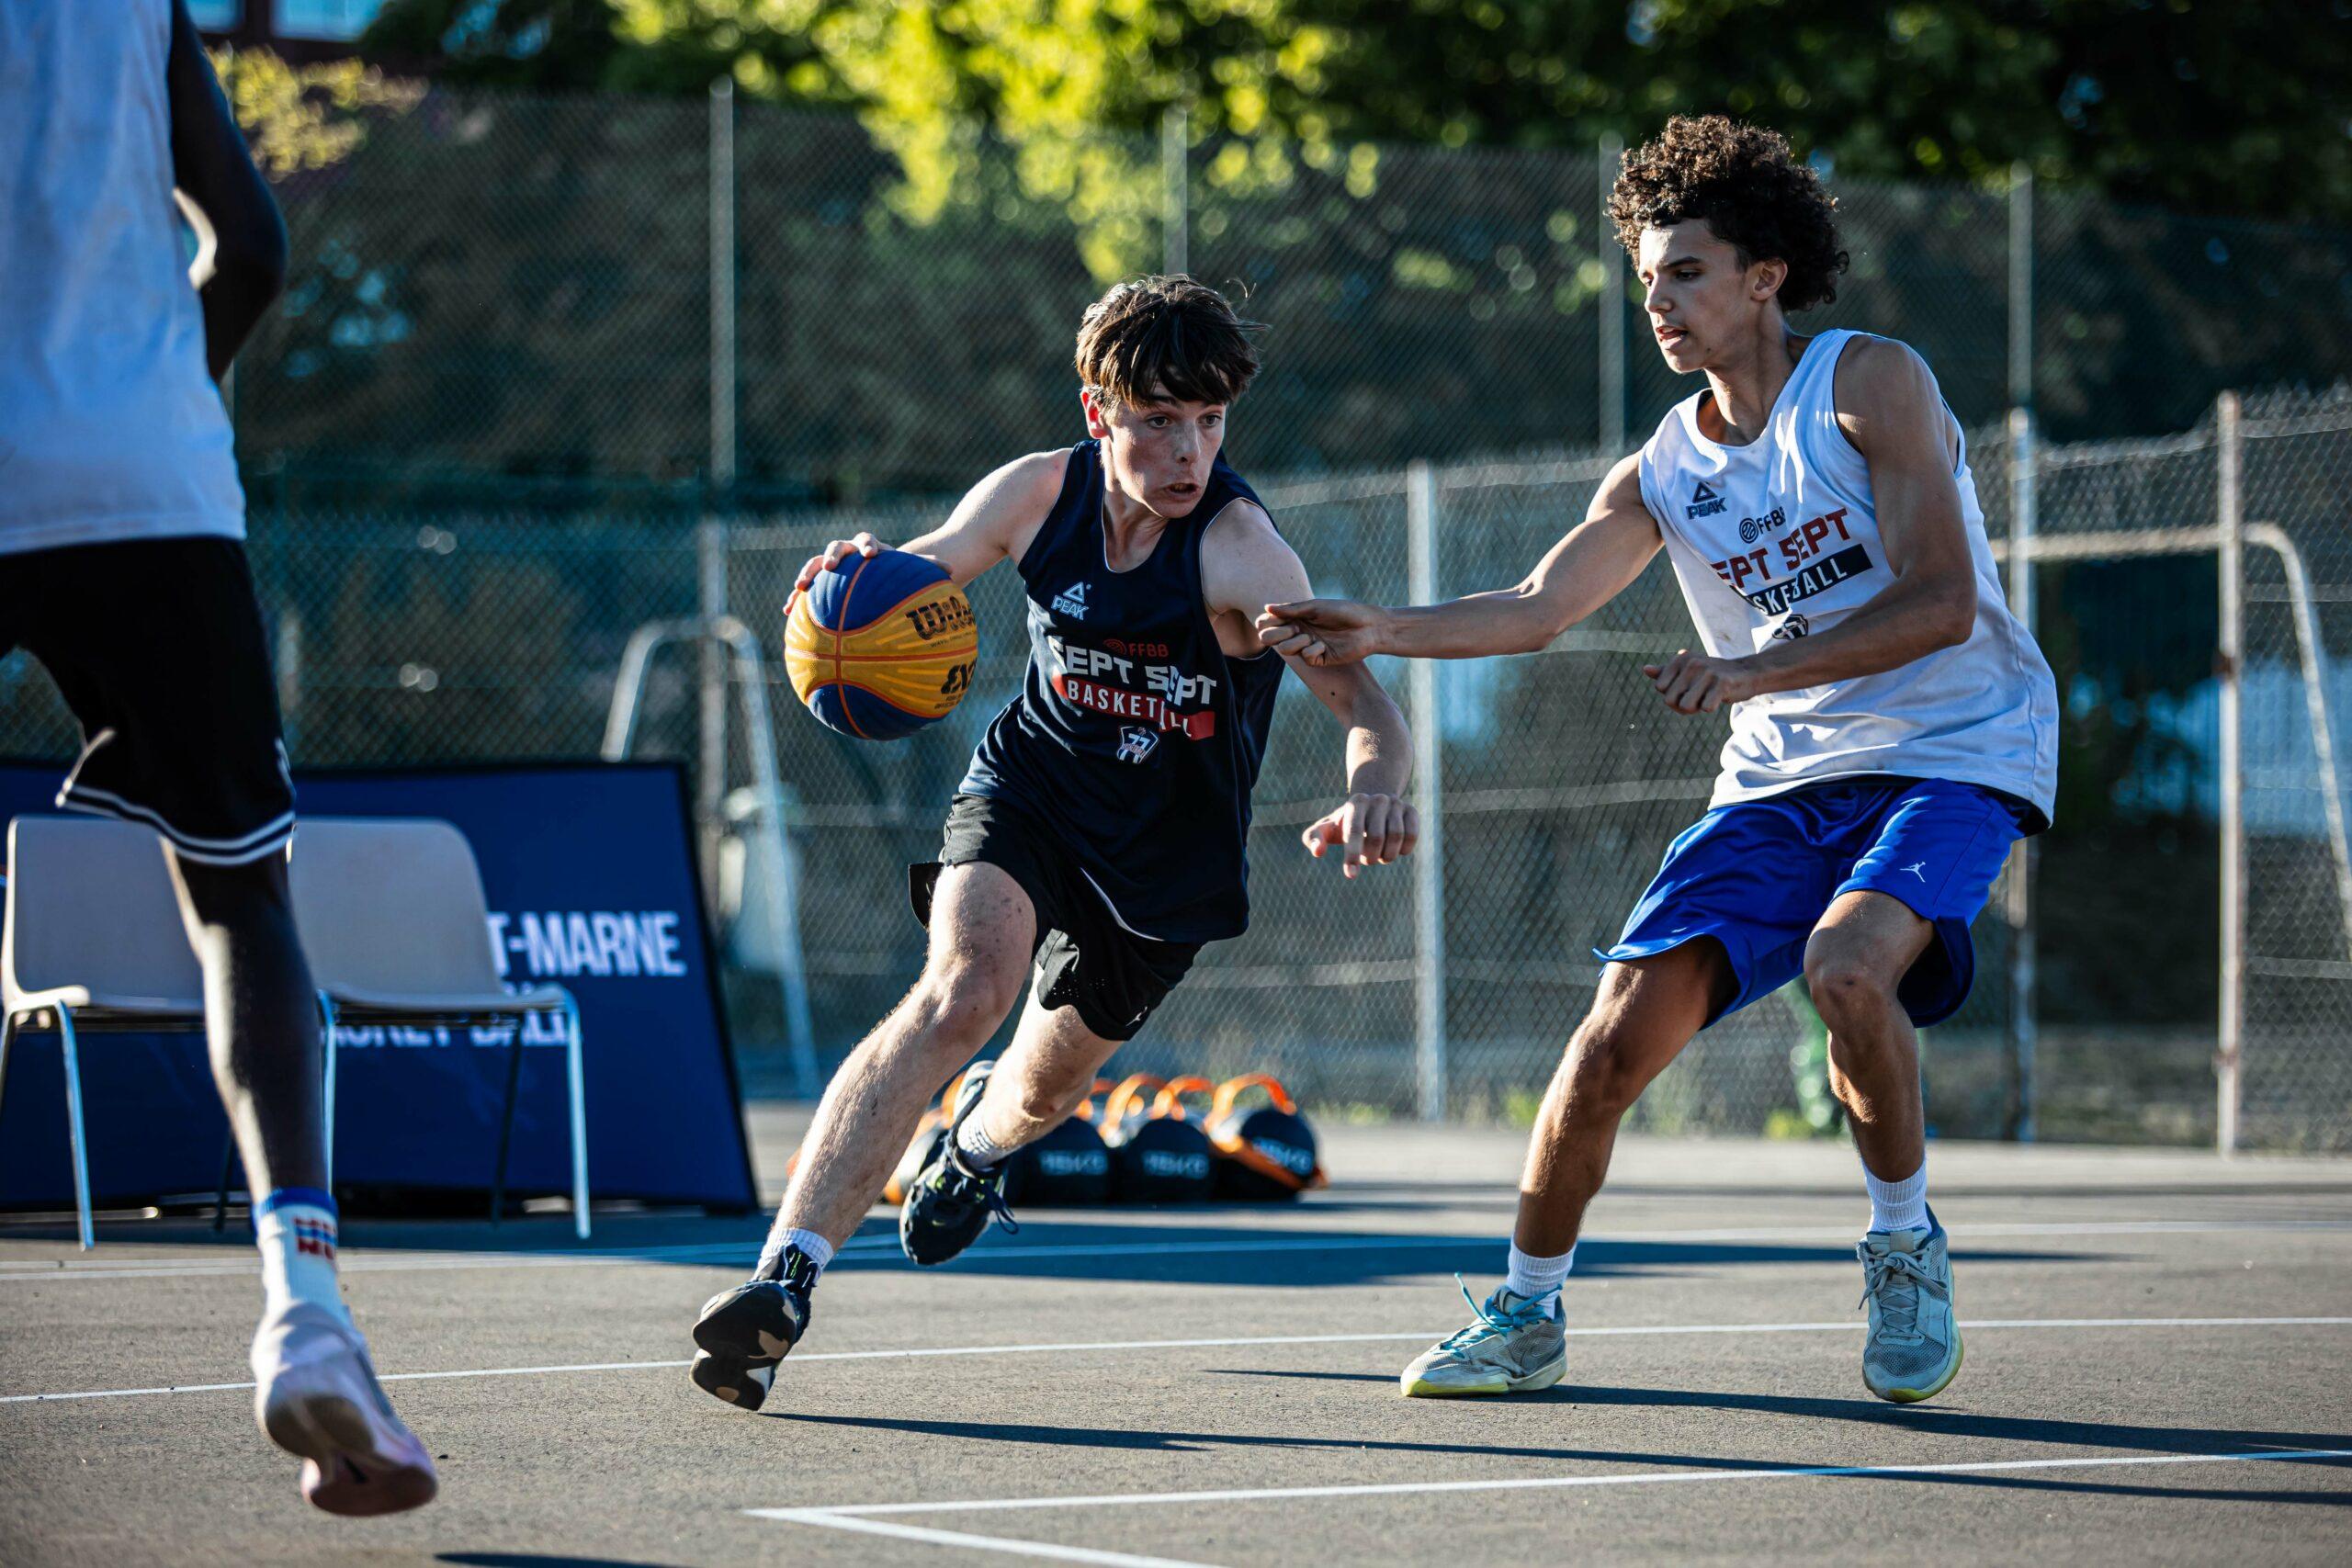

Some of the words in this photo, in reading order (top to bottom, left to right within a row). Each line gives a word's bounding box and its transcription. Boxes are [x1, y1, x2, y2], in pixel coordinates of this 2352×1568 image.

[1686, 497, 1728, 520] PEAK
[1050, 595, 1090, 621] PEAK
[1129, 643, 1169, 658] FFBB
